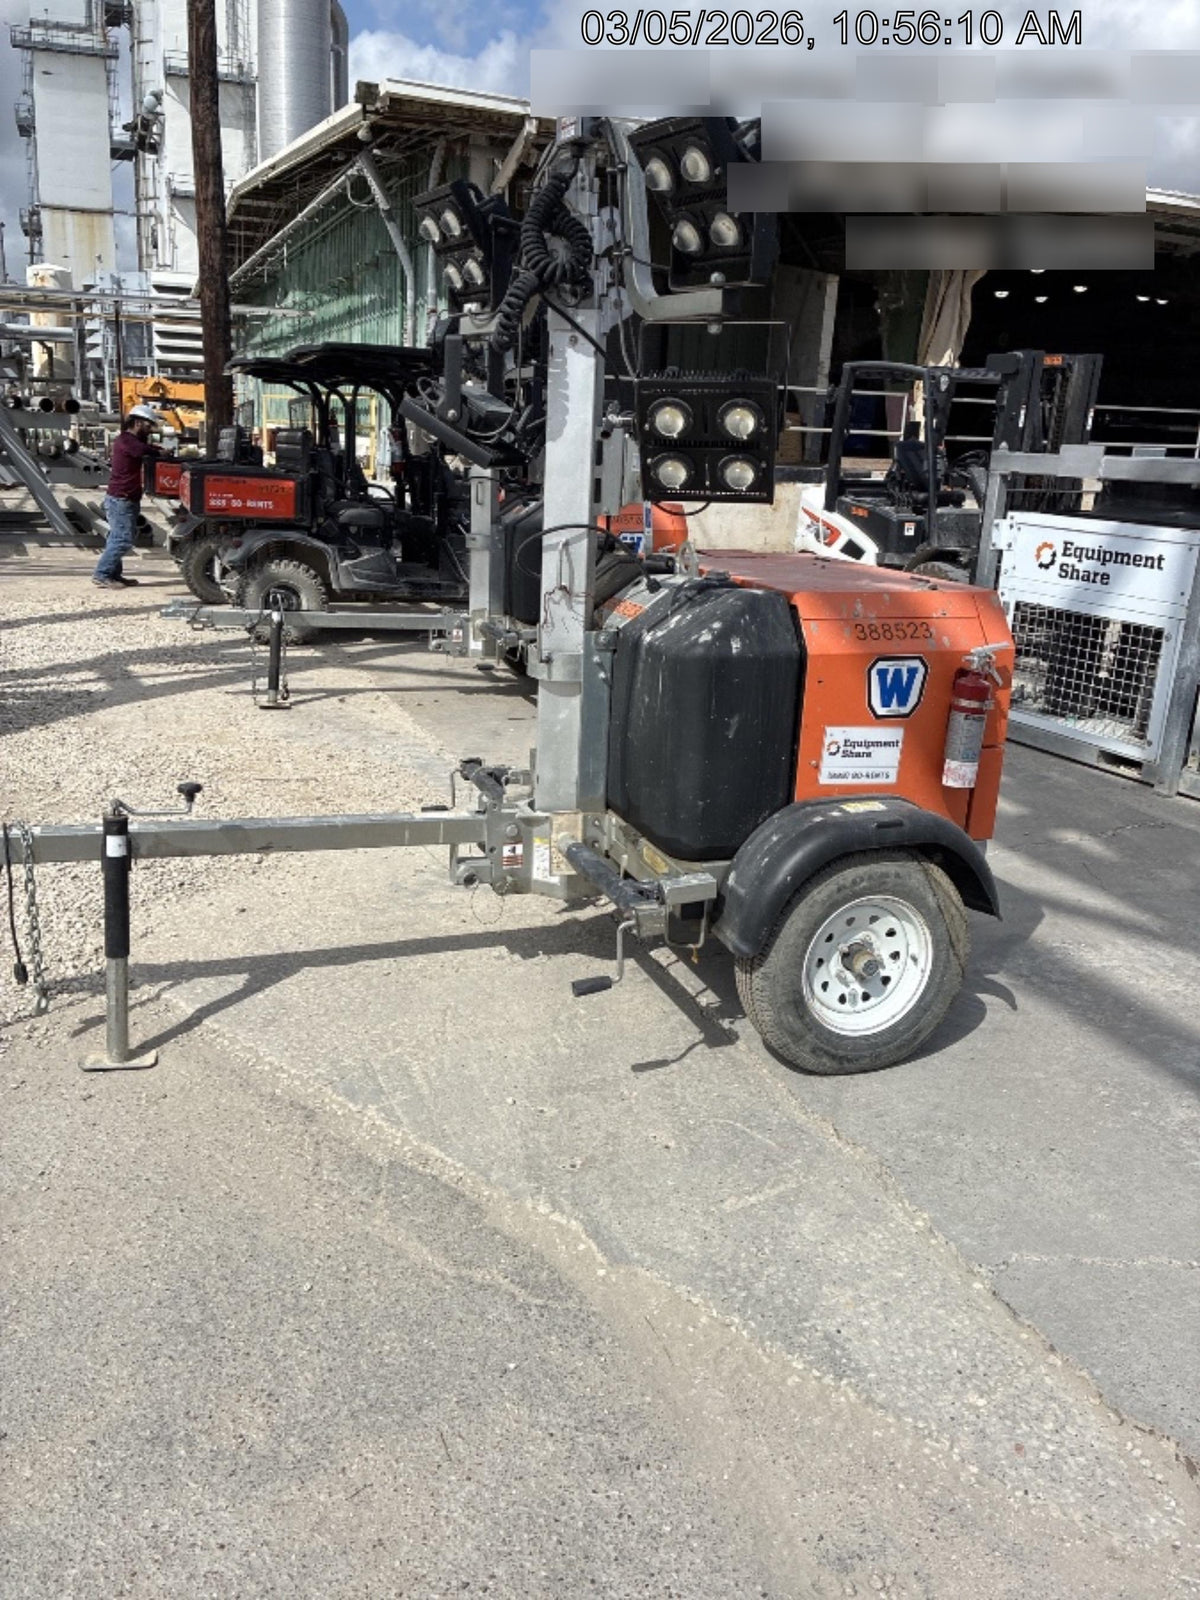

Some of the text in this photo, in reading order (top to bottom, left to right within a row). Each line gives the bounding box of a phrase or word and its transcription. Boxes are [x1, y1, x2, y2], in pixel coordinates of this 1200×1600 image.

[1061, 541, 1165, 571] Equipment
[1058, 563, 1110, 586] Share
[855, 621, 933, 641] 388523
[876, 666, 919, 708] W
[841, 750, 872, 758] Share
[842, 739, 900, 749] Equipment
